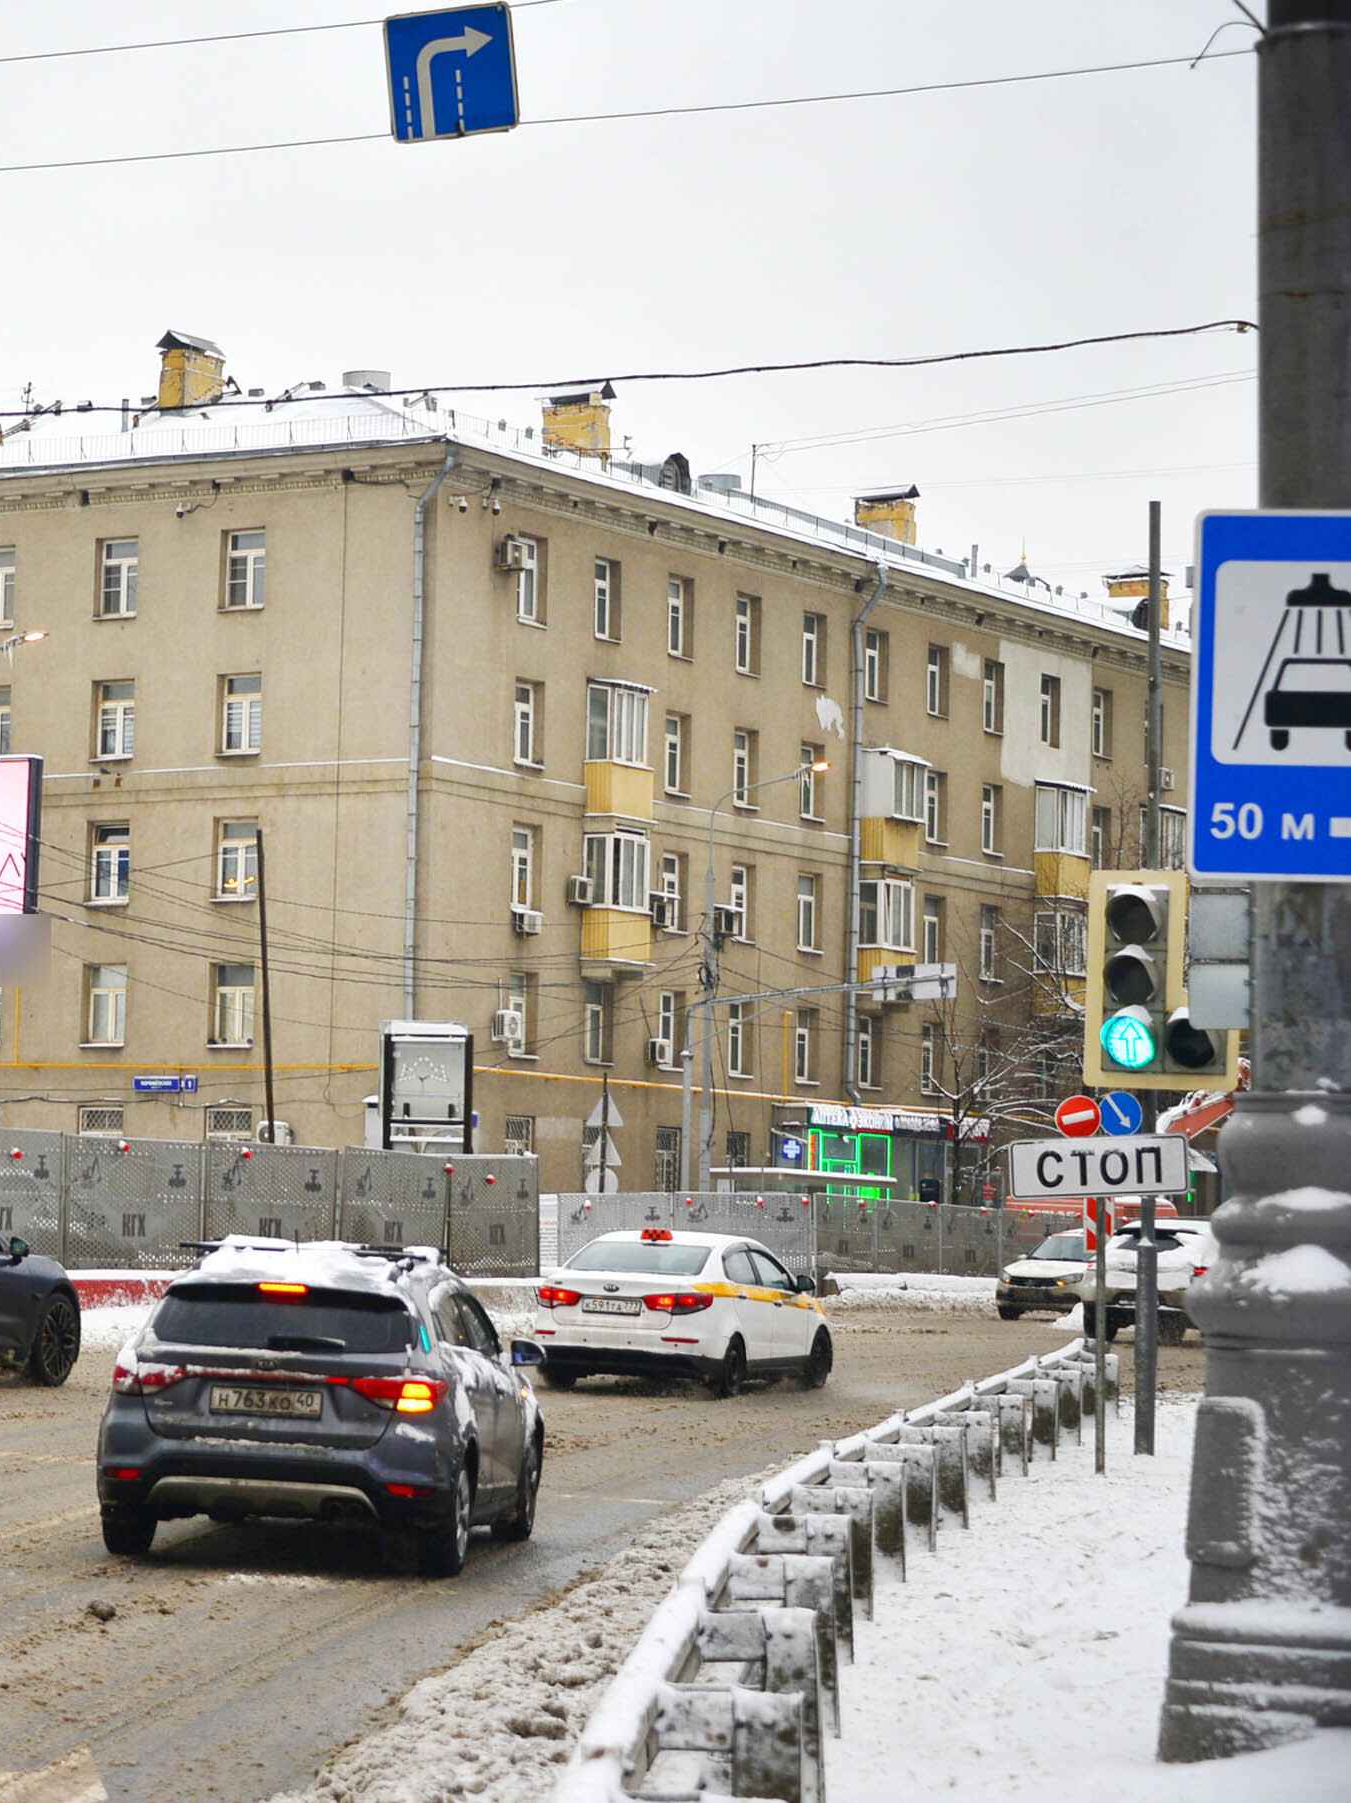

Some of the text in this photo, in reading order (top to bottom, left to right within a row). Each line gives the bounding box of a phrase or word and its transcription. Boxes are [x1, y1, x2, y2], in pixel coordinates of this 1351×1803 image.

[1210, 802, 1314, 840] 50 м
[1037, 1146, 1163, 1189] СТОП
[122, 1212, 146, 1237] КГХ
[259, 1217, 282, 1239] КГХ
[296, 1393, 314, 1407] 40
